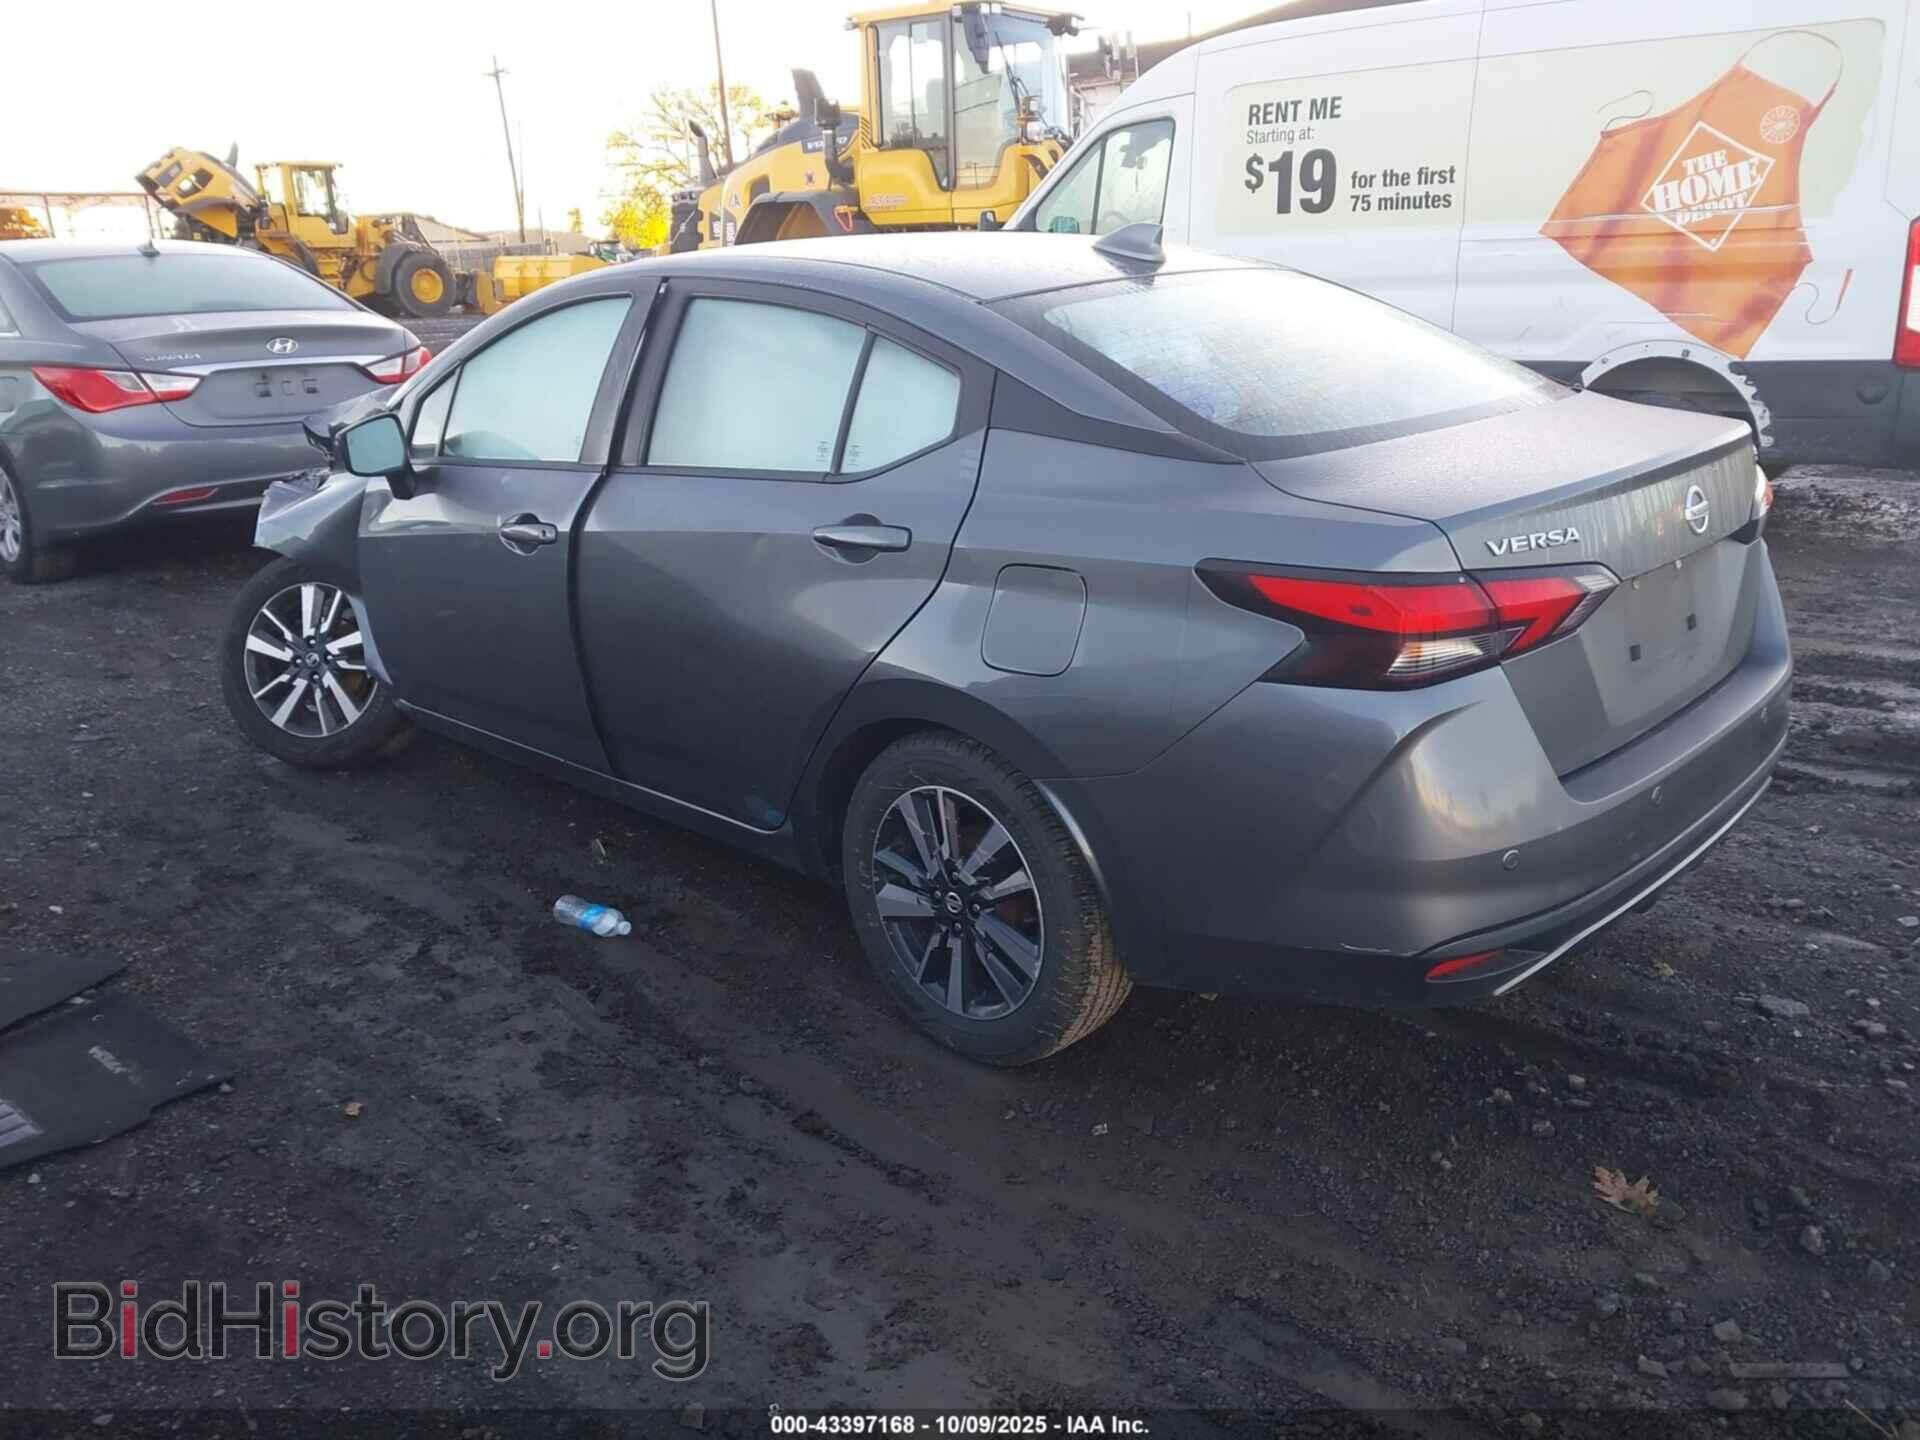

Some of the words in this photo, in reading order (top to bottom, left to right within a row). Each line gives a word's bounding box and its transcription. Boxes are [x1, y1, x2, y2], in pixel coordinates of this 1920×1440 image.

[1248, 100, 1303, 126] RENT
[1309, 96, 1343, 120] ME
[1246, 128, 1295, 144] Starting
[1298, 126, 1316, 140] at:
[1682, 149, 1728, 176] THE
[1244, 148, 1337, 214] $19
[1351, 170, 1377, 189] for
[1382, 169, 1411, 187] the
[1417, 165, 1456, 185] first
[1653, 156, 1764, 213] HOME
[1350, 194, 1371, 212] 75
[1378, 190, 1452, 211] minutes
[1485, 527, 1580, 556] VERSA
